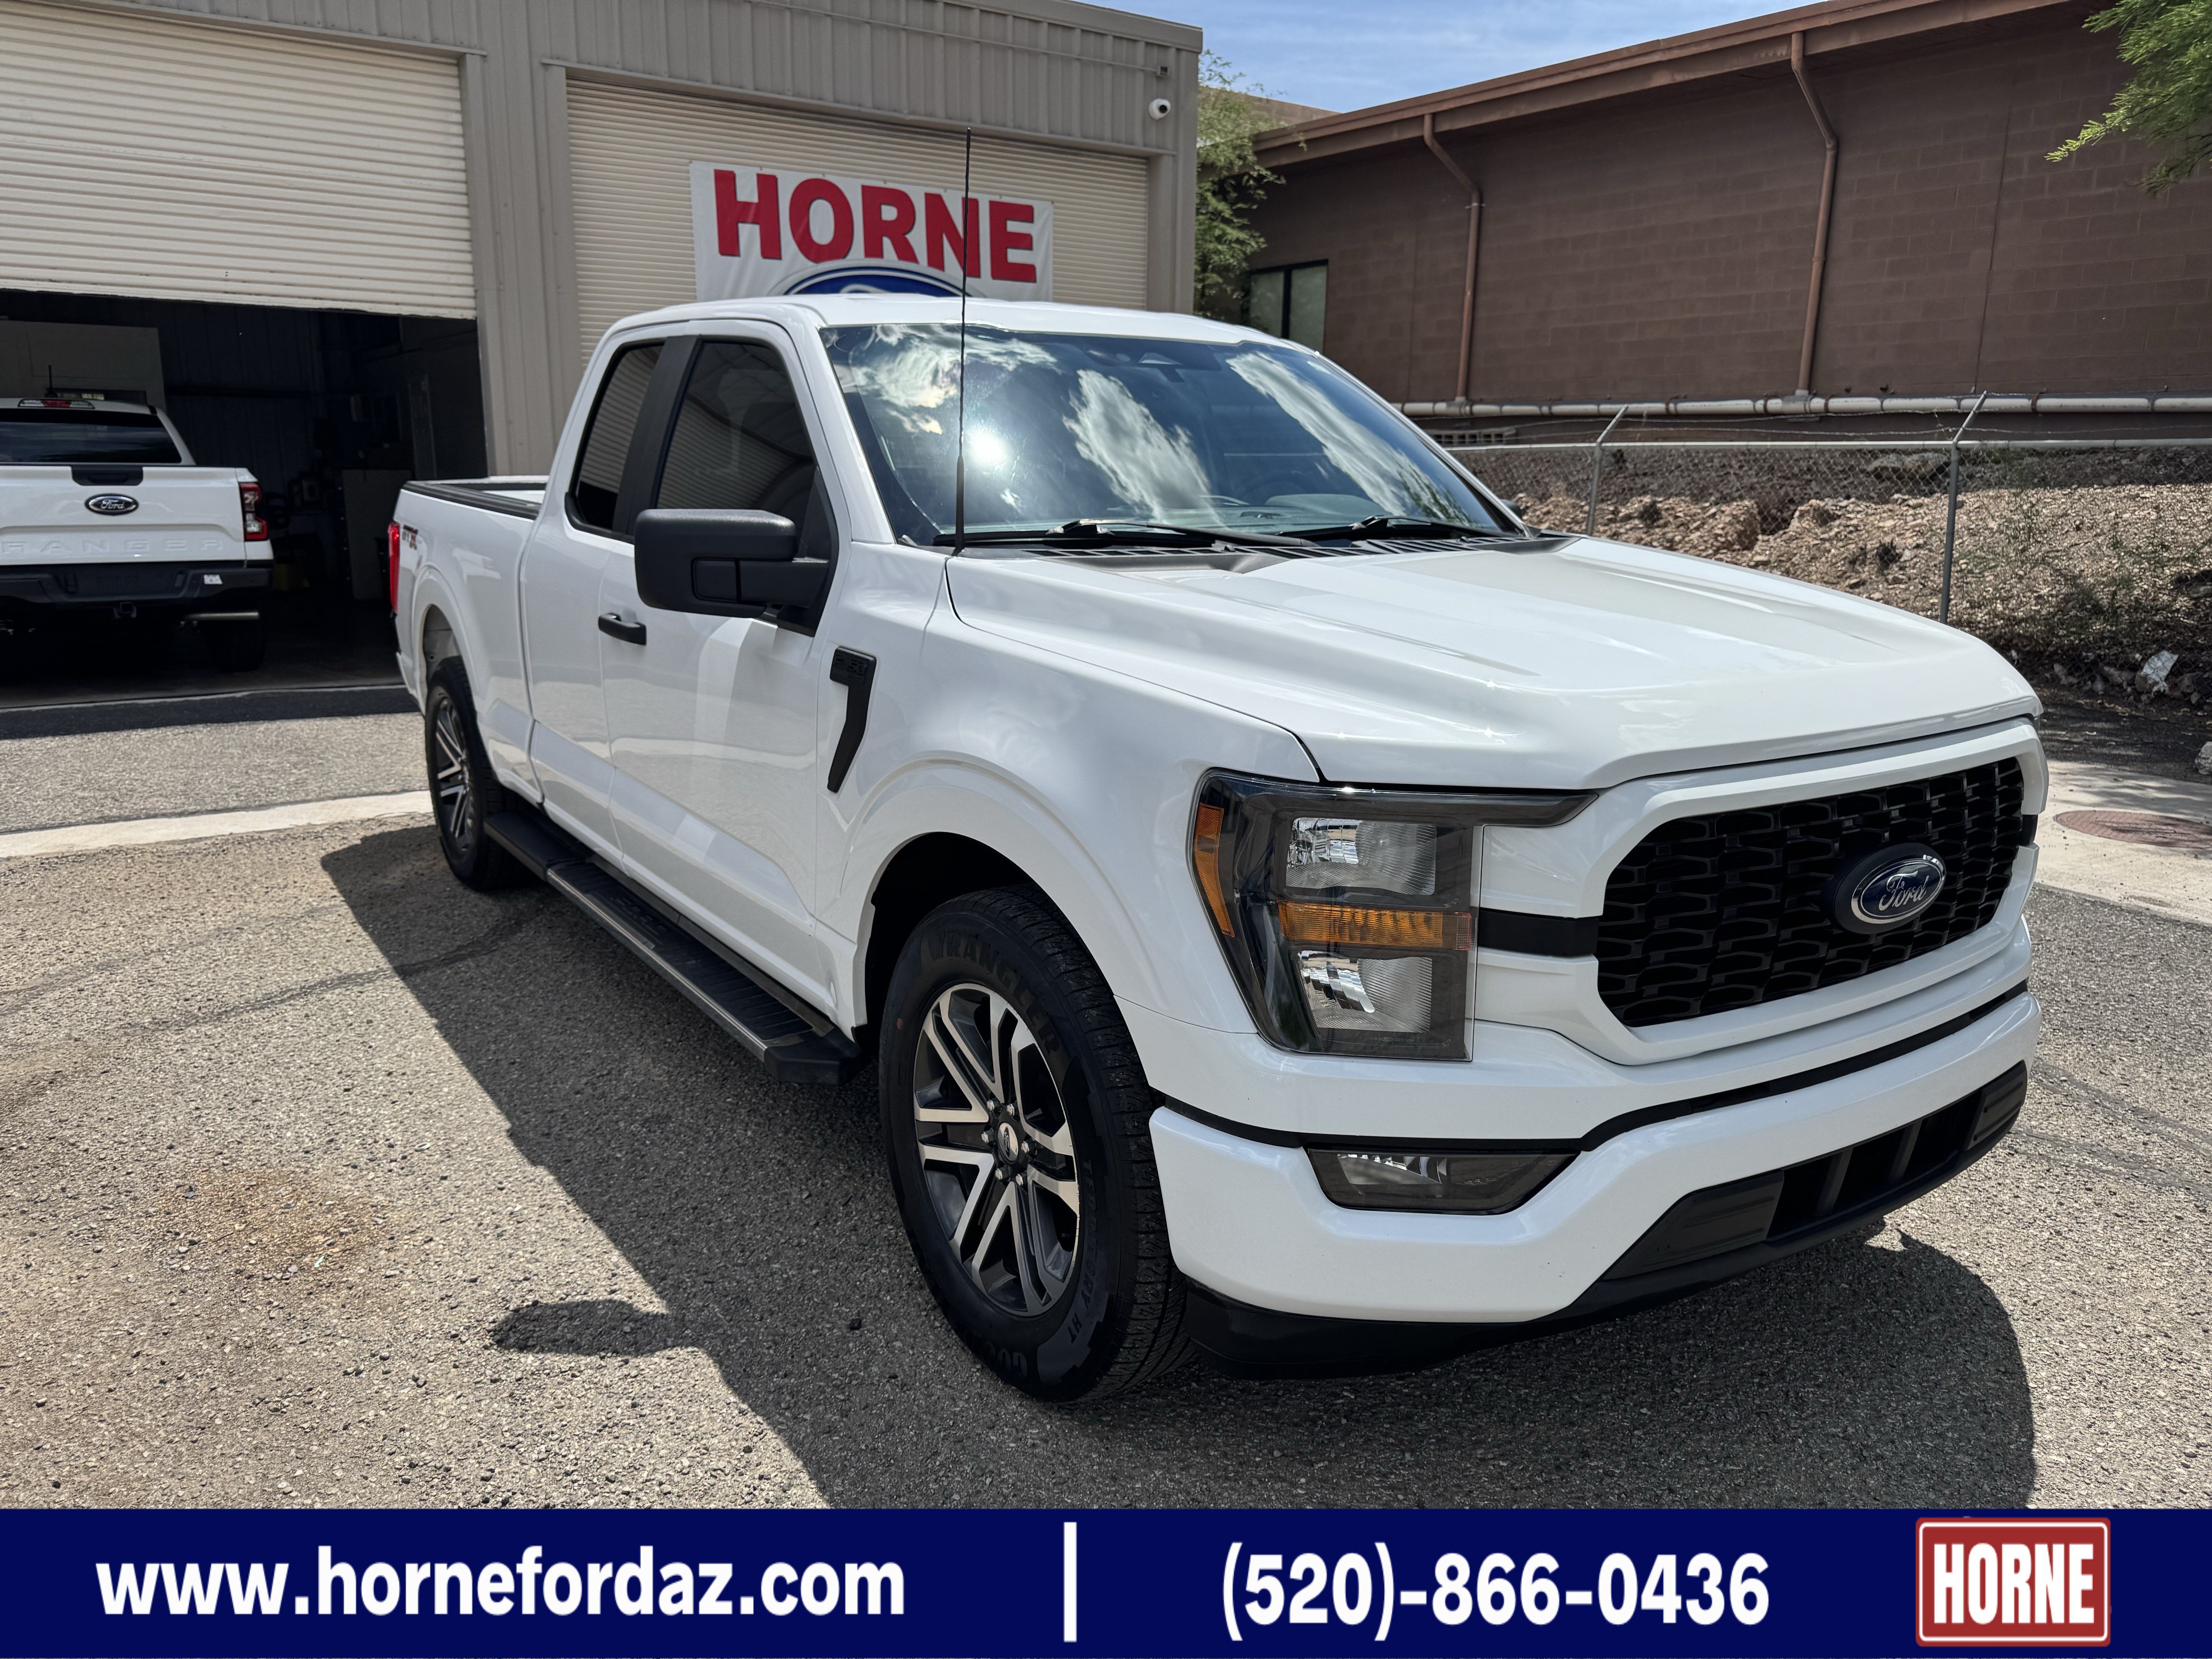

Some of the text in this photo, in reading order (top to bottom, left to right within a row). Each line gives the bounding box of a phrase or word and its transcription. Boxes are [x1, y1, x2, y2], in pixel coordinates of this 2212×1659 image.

[713, 168, 1037, 283] HORNE
[100, 497, 125, 510] Ford
[2, 538, 223, 553] RANGER
[1879, 870, 1930, 911] Ford
[928, 931, 1060, 1056] WRANGLER
[1066, 1159, 1099, 1344] TERRITORY HT
